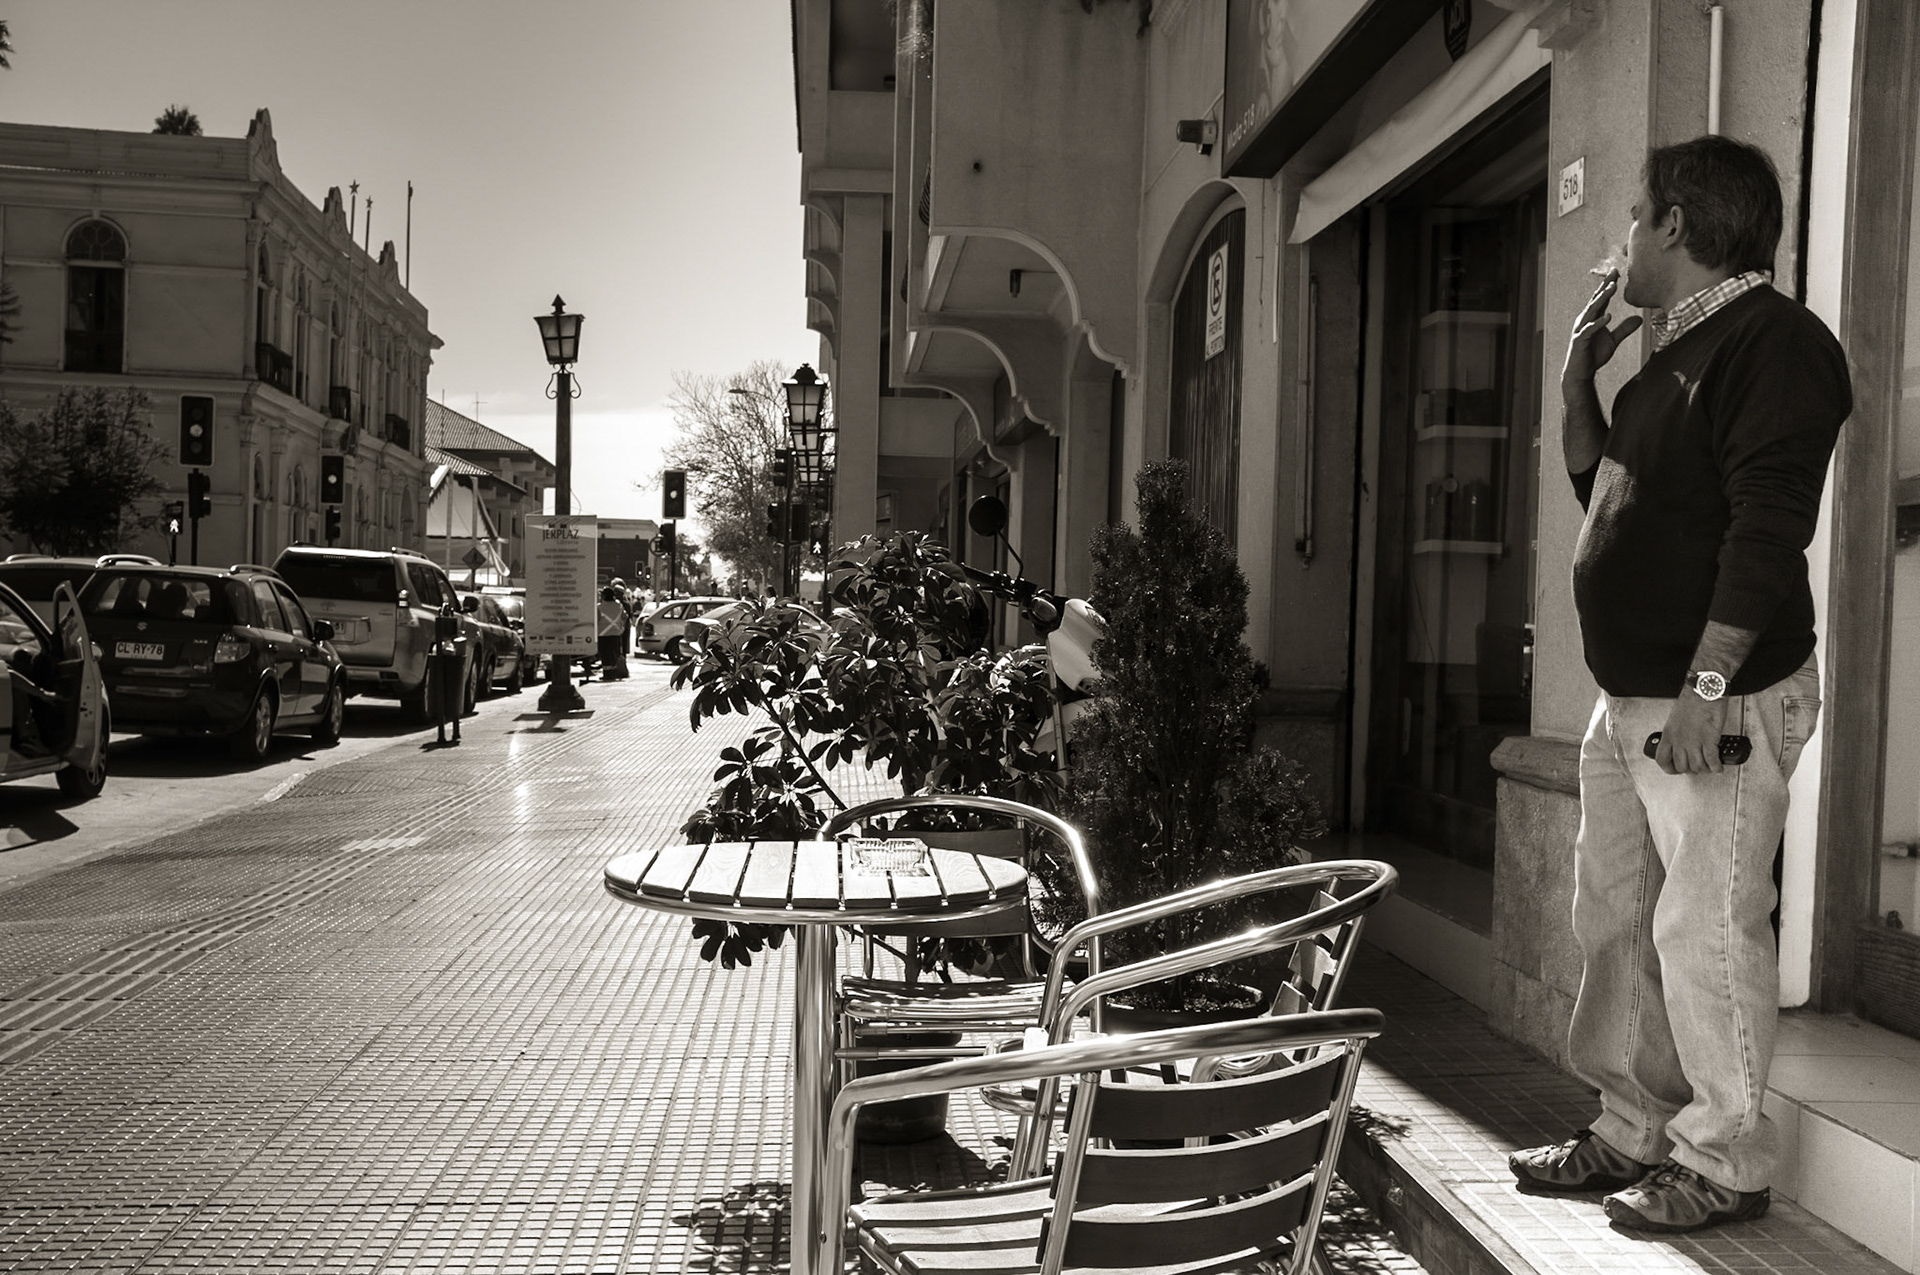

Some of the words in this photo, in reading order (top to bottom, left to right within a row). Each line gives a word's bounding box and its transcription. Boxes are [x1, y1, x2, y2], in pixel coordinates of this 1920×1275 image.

[1243, 103, 1255, 135] 518
[1563, 173, 1578, 201] 518
[542, 529, 579, 542] JERPLAZ
